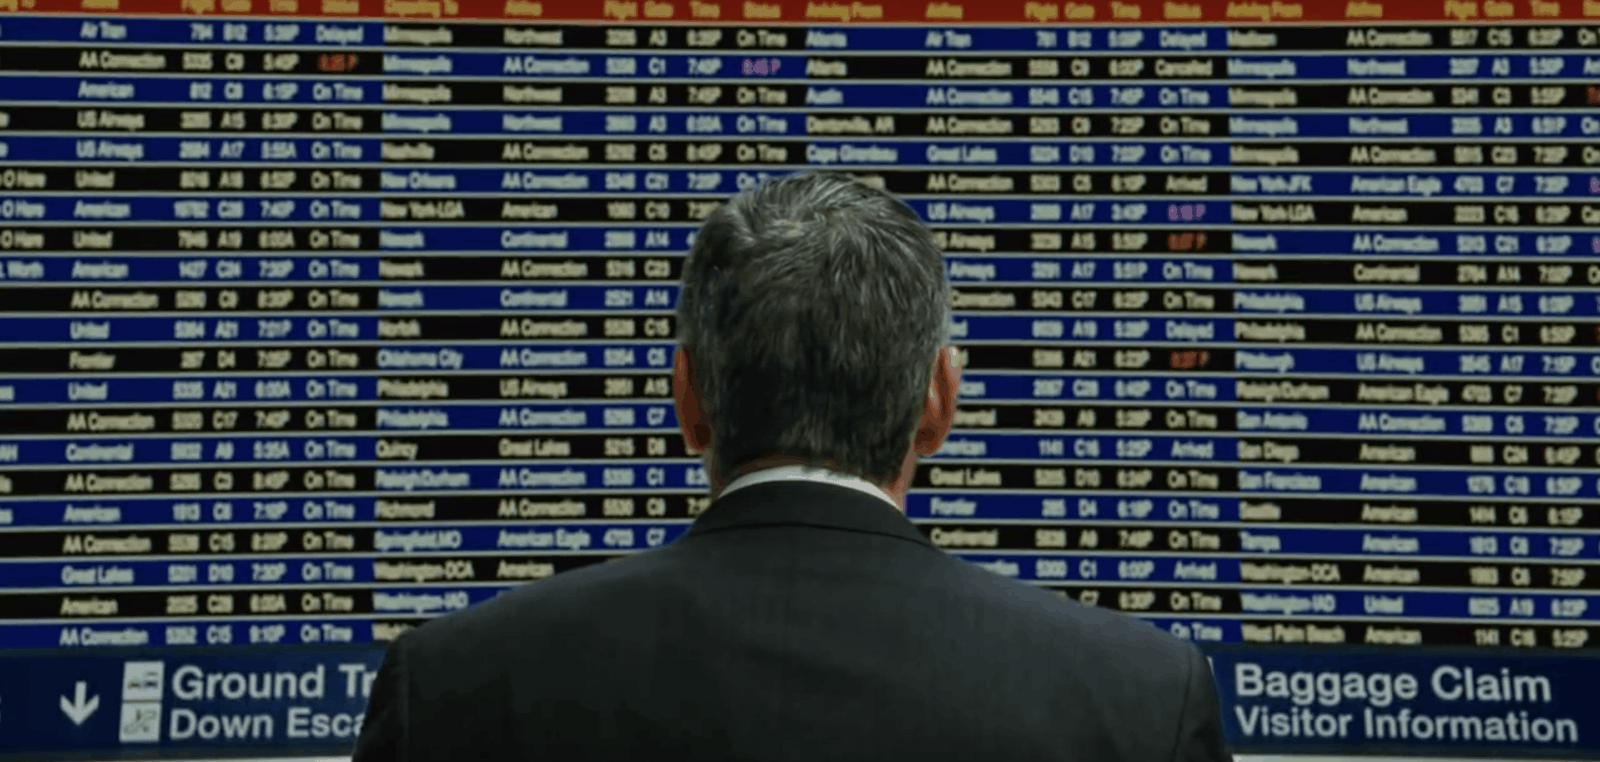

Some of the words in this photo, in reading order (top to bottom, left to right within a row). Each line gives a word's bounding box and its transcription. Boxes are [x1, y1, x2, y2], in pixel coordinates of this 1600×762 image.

[172, 664, 325, 700] Ground
[1235, 663, 1418, 707] Baggage
[1431, 666, 1551, 701] Claim
[170, 708, 273, 739] Down
[1235, 705, 1352, 737] Visitor
[1364, 708, 1577, 741] Information
